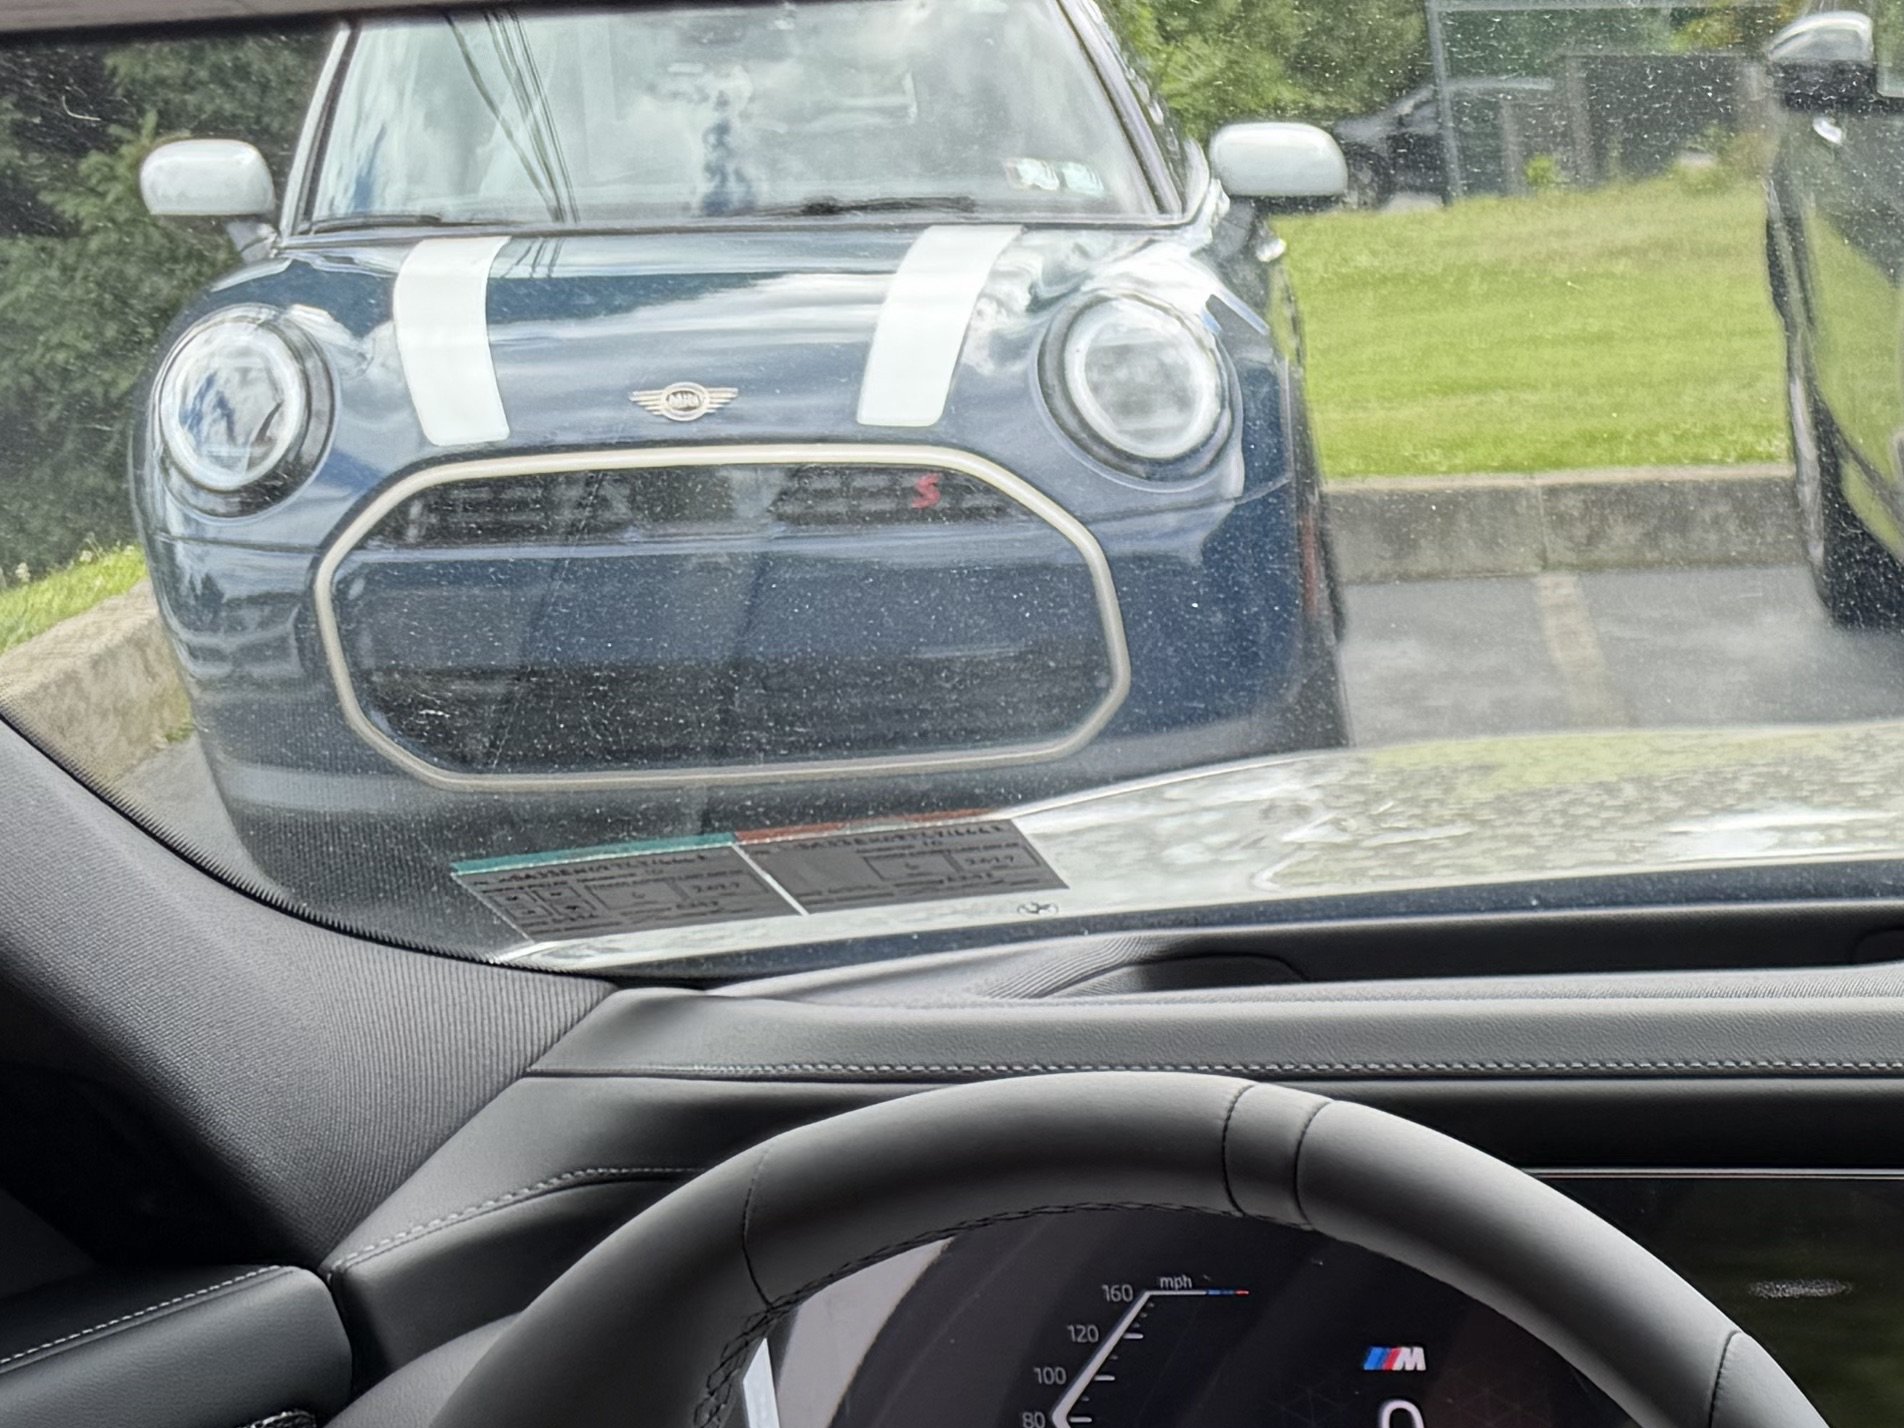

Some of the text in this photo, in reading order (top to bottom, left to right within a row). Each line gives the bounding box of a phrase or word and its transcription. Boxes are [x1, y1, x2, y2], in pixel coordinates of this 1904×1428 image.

[911, 471, 942, 509] S
[1159, 1274, 1193, 1291] mph
[1101, 1284, 1134, 1302] 160
[1066, 1324, 1100, 1343] 120
[1033, 1367, 1068, 1385] 100
